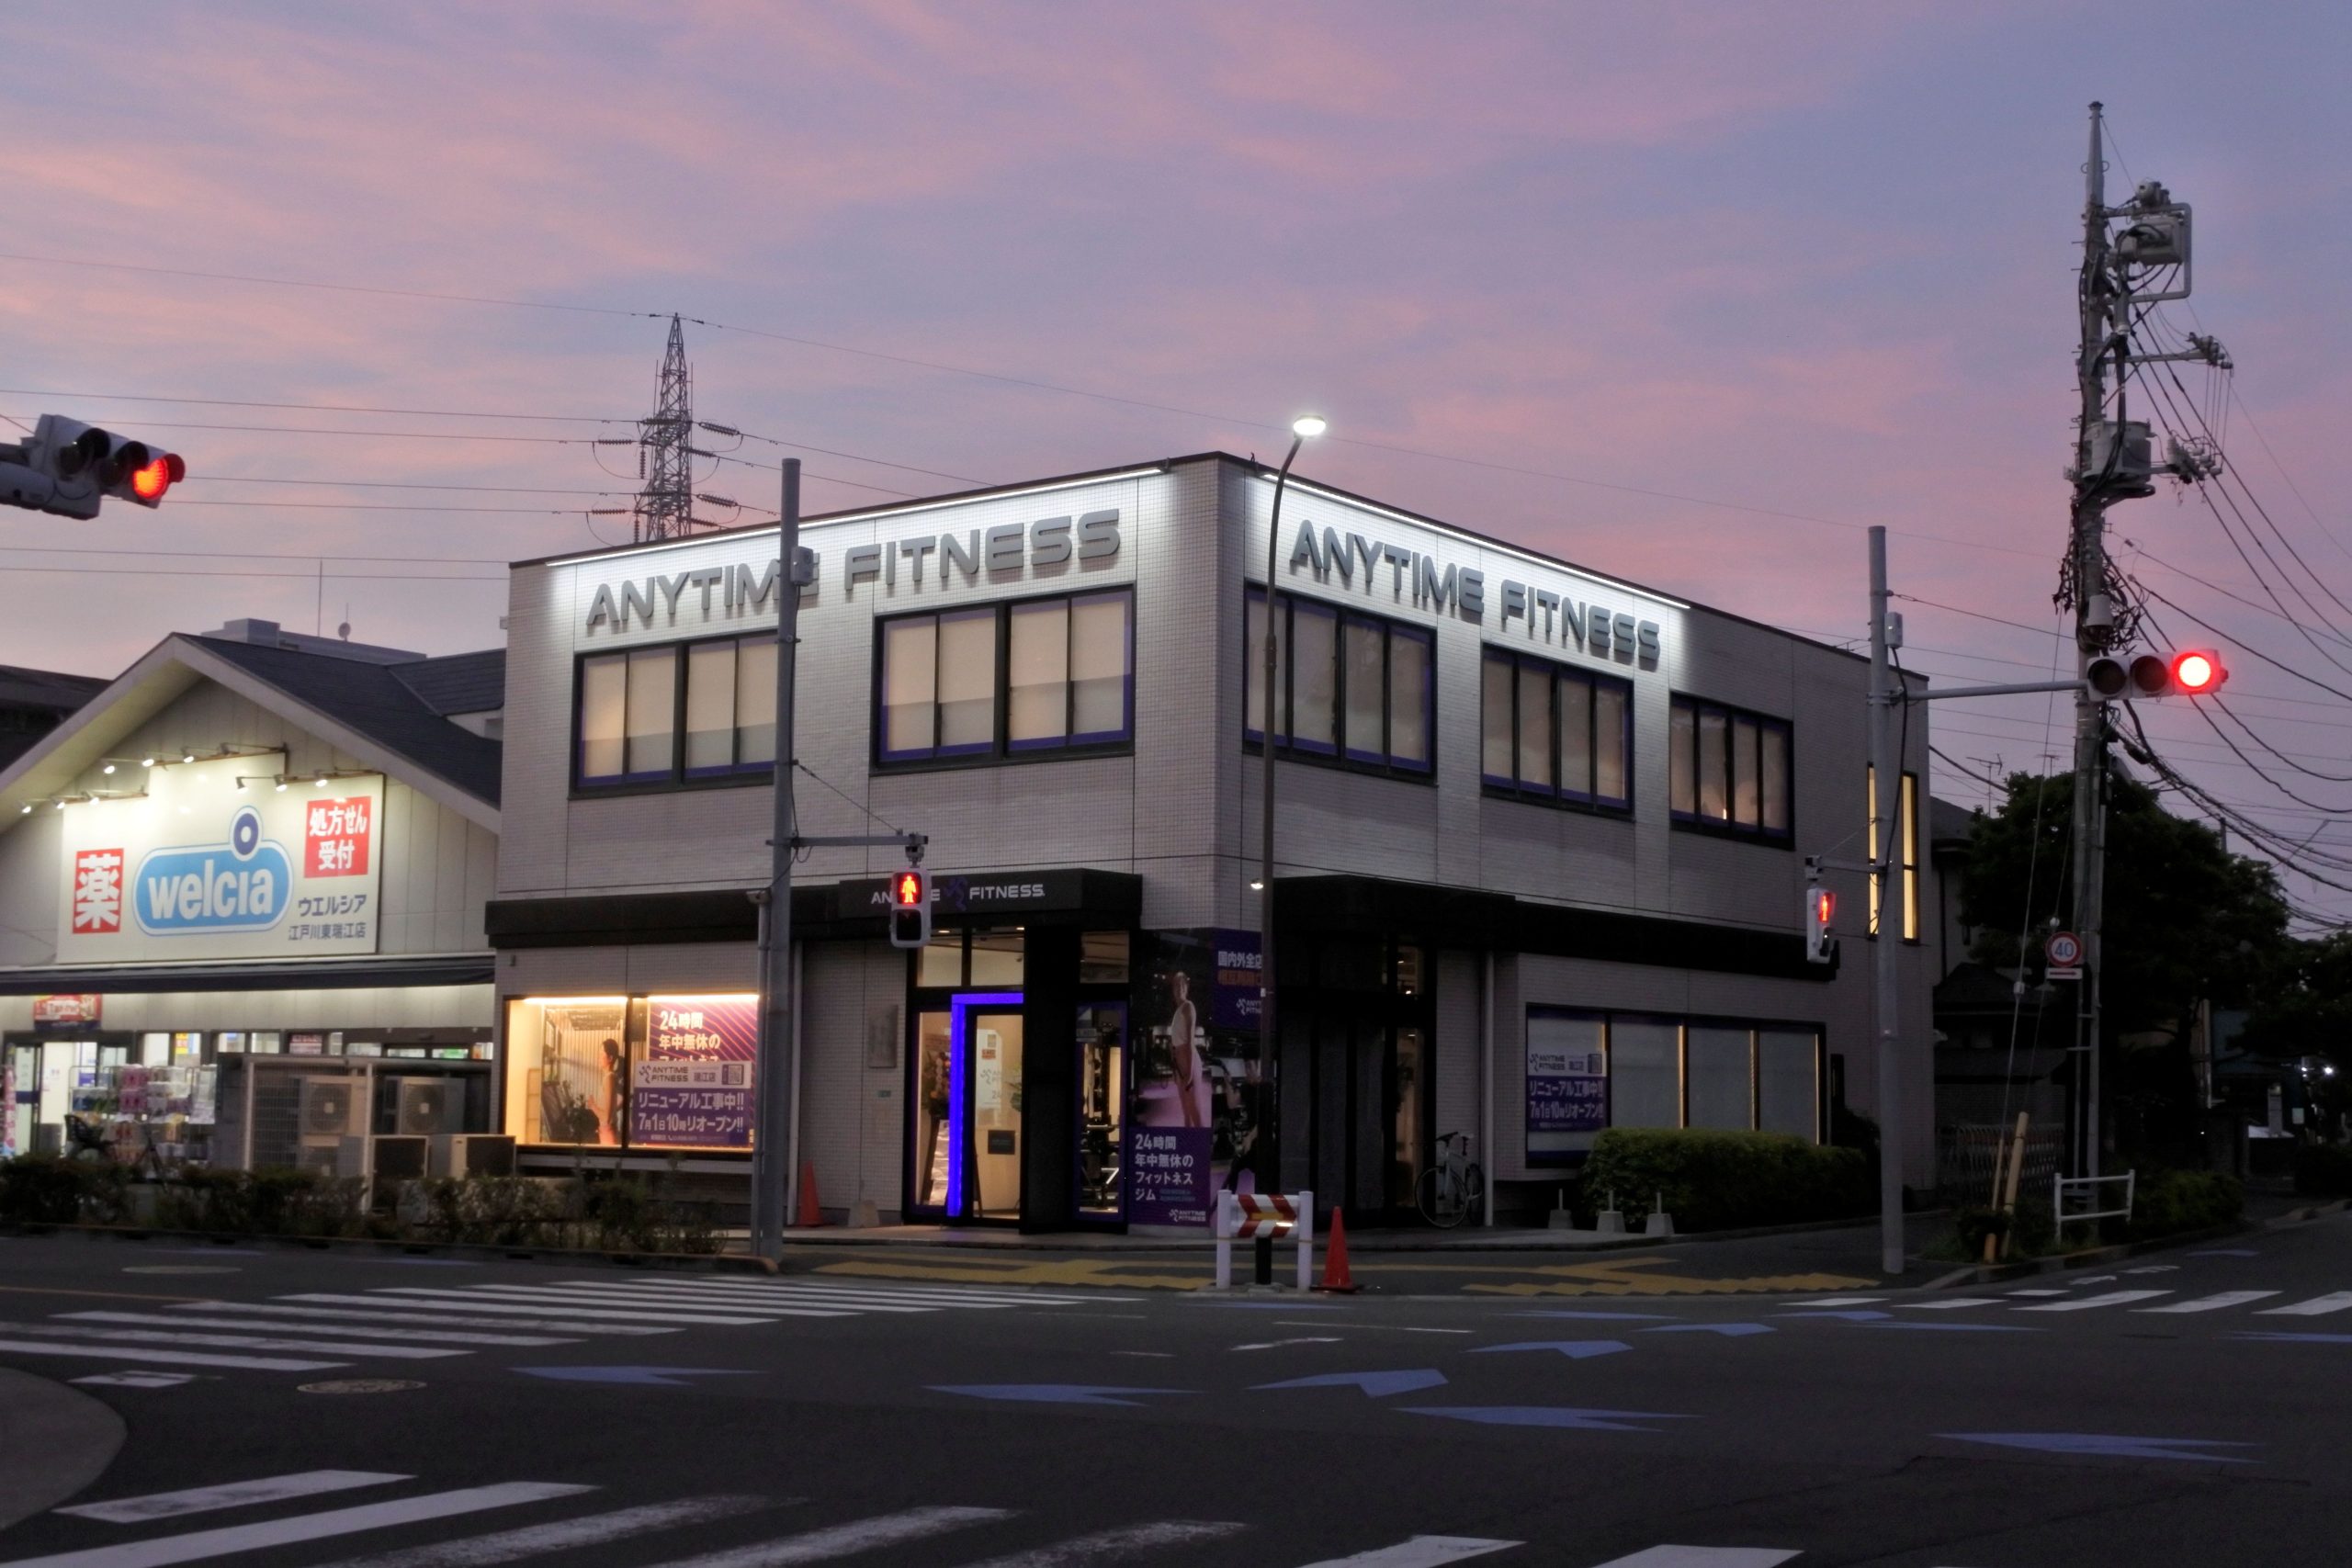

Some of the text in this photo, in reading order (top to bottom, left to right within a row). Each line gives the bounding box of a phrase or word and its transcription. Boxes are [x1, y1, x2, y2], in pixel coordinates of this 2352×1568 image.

[844, 509, 1120, 592] FITNESS
[1290, 519, 1660, 660] ANYTIME FITNESS
[309, 806, 368, 838] 処方せん
[318, 839, 356, 871] 受付
[74, 853, 121, 930] 薬
[147, 859, 274, 920] welcia
[969, 884, 1046, 900] FITNESS
[297, 894, 368, 918] ウエルシア
[2054, 942, 2074, 957] 40
[659, 1010, 704, 1031] 24時間
[659, 1033, 721, 1051] 年中無休の
[1135, 1133, 1177, 1151] 24時間
[1135, 1153, 1194, 1168] 年中無休の
[1135, 1171, 1193, 1185] フィットネス
[1135, 1188, 1156, 1201] ジム
